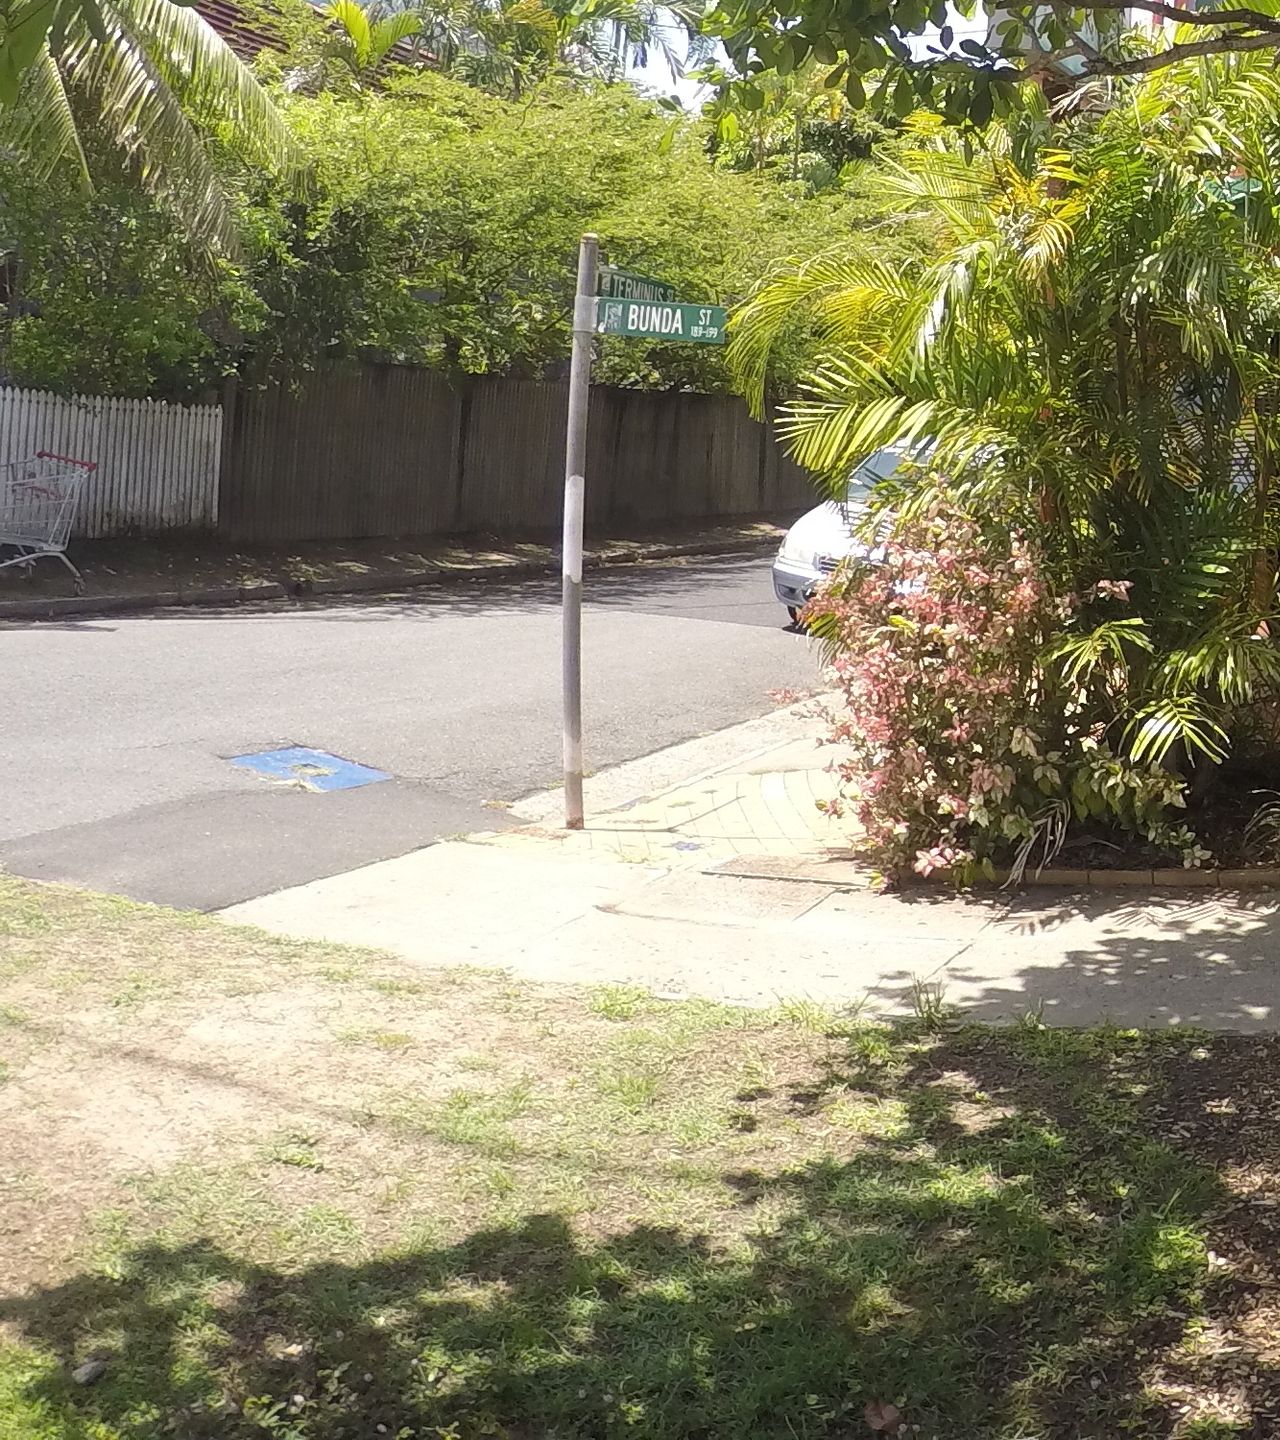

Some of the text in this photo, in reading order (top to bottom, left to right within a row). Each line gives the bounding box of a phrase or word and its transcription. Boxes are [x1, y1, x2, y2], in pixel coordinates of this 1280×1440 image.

[613, 274, 664, 303] TERMINUS
[628, 304, 712, 335] BUNDA ST
